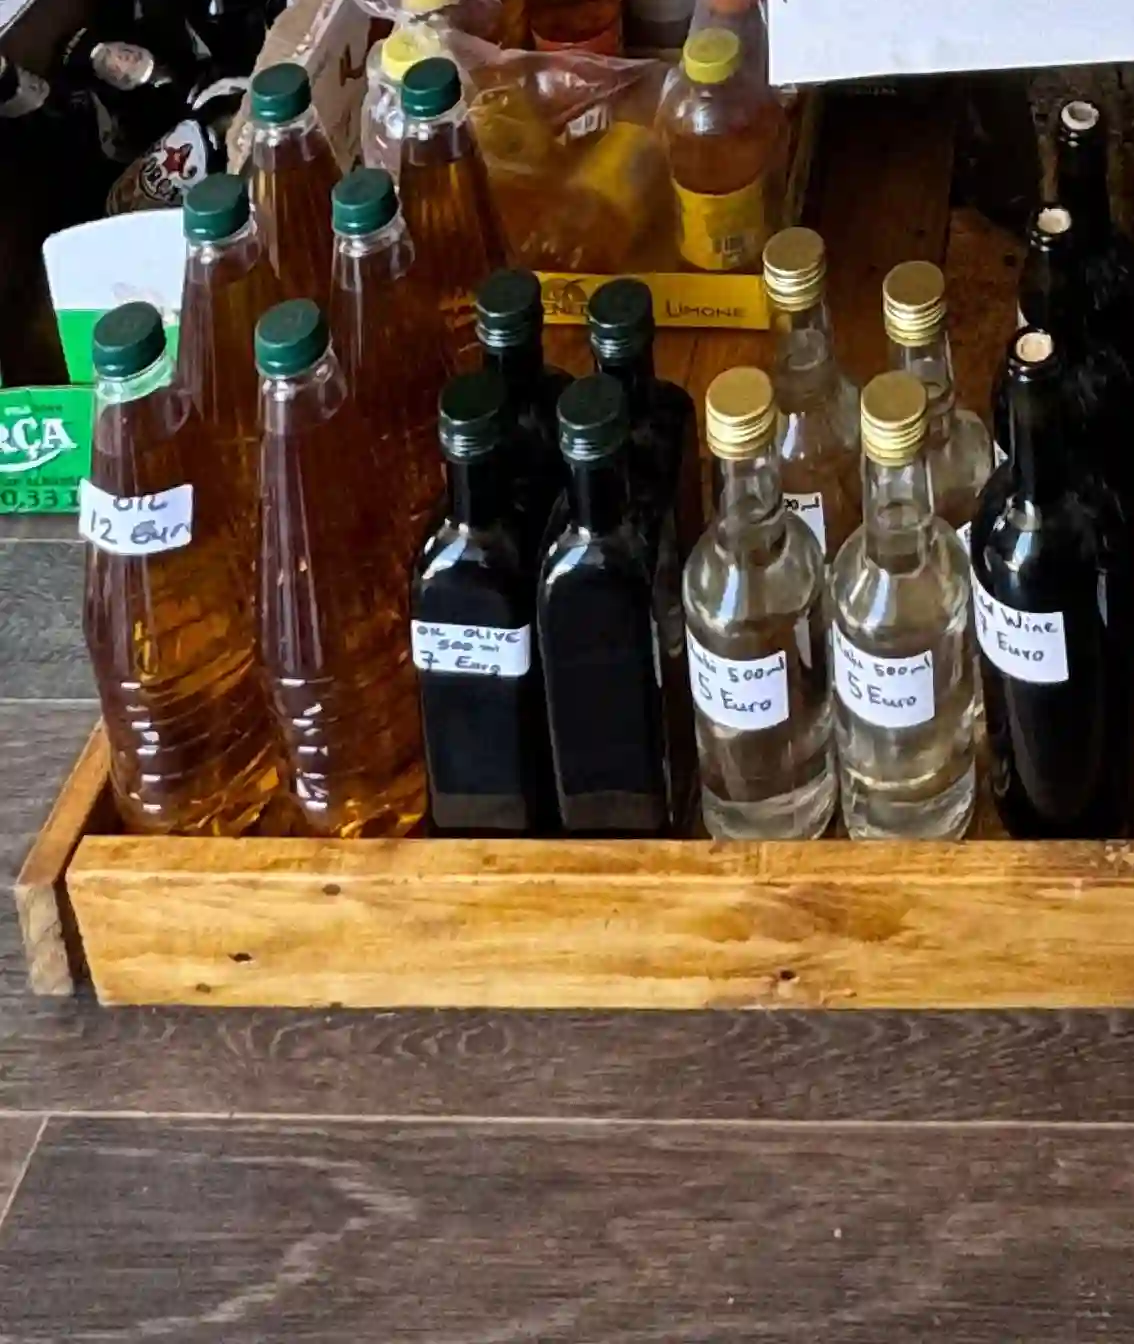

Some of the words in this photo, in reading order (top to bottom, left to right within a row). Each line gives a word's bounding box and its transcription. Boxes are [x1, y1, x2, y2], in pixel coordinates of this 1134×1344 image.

[666, 300, 749, 318] LIMONE
[91, 511, 117, 544] 12
[417, 625, 445, 636] OIL
[464, 628, 520, 643] OLIVE
[1000, 607, 1058, 634] Wine
[437, 639, 473, 651] 500
[996, 631, 1044, 661] Euro
[420, 650, 440, 672] 7
[455, 655, 500, 675] Euro
[698, 671, 713, 701] 5
[720, 687, 771, 712] Euro
[847, 670, 862, 700] 5
[867, 684, 917, 708] Euro
